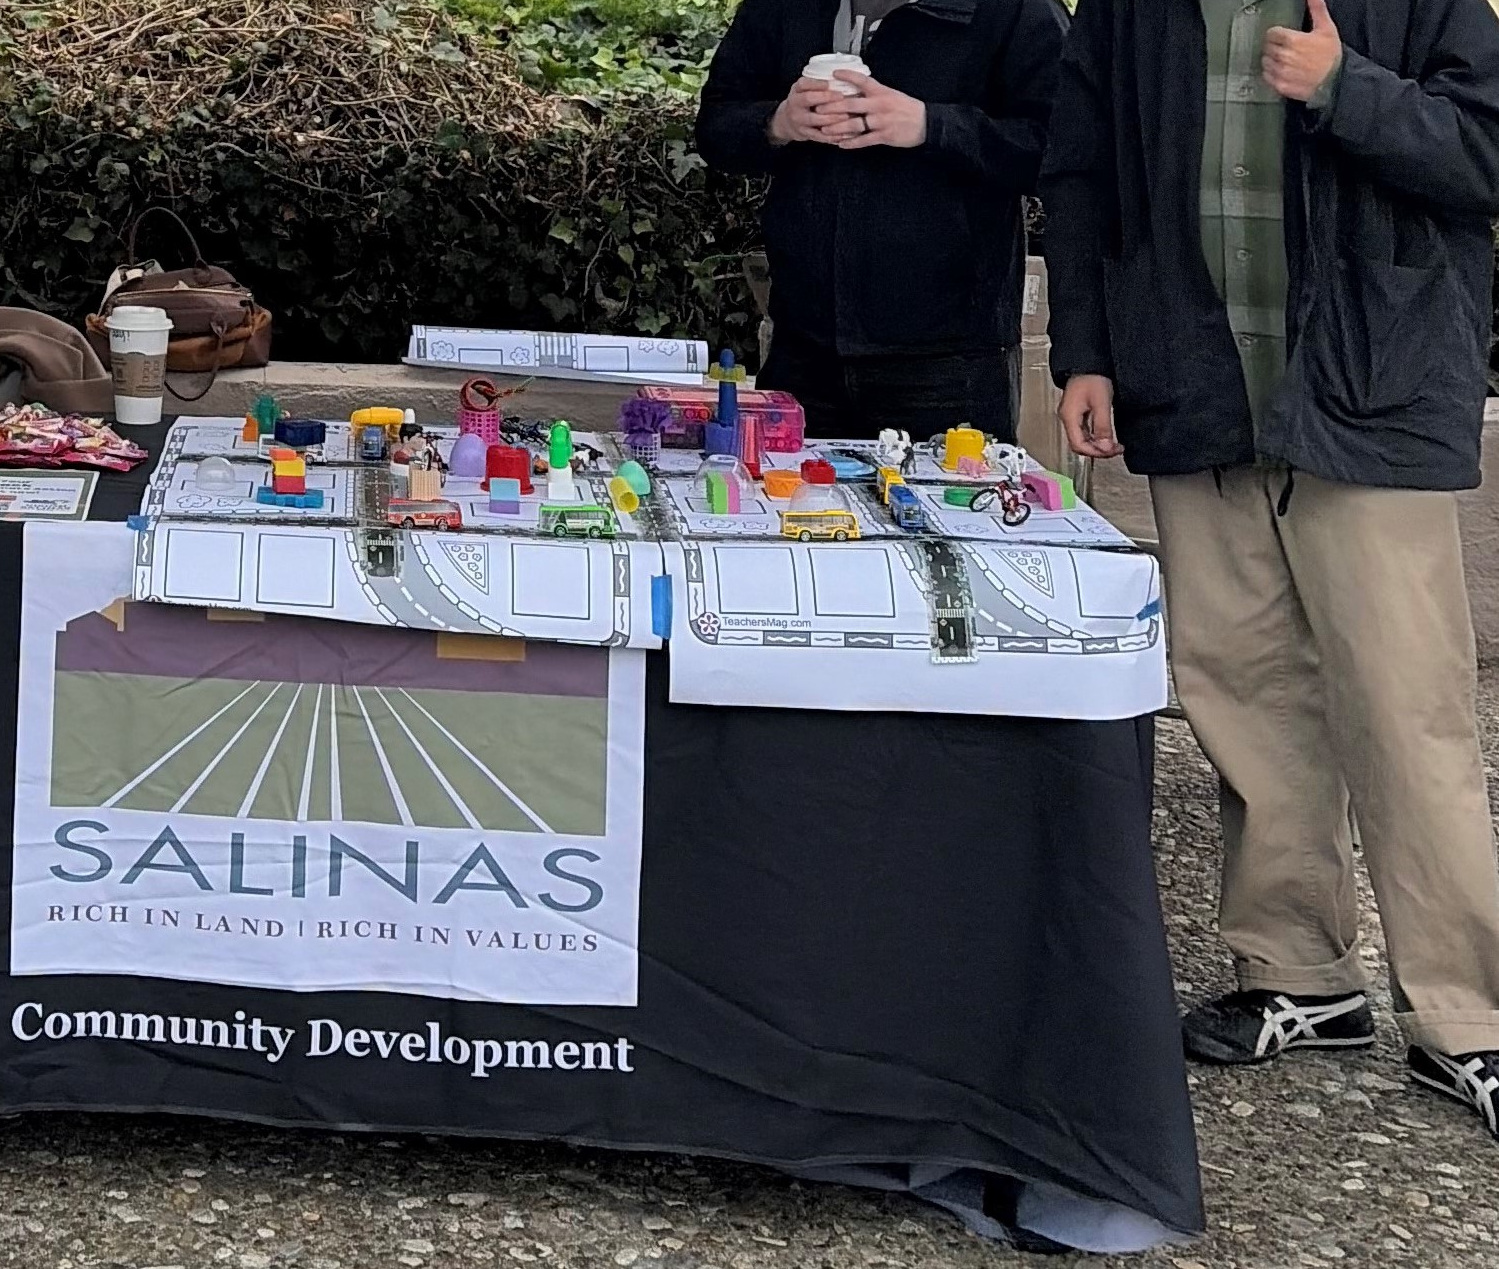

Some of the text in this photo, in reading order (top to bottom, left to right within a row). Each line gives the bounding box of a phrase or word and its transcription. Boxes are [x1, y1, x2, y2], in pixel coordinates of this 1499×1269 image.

[49, 820, 604, 913] SALINAS
[48, 905, 129, 923] RICH
[144, 908, 181, 927] IN
[195, 913, 284, 937] LAND
[316, 921, 398, 940] RICH
[414, 926, 451, 945] IN
[465, 930, 598, 951] VALUES
[11, 1002, 635, 1077] Community Development
